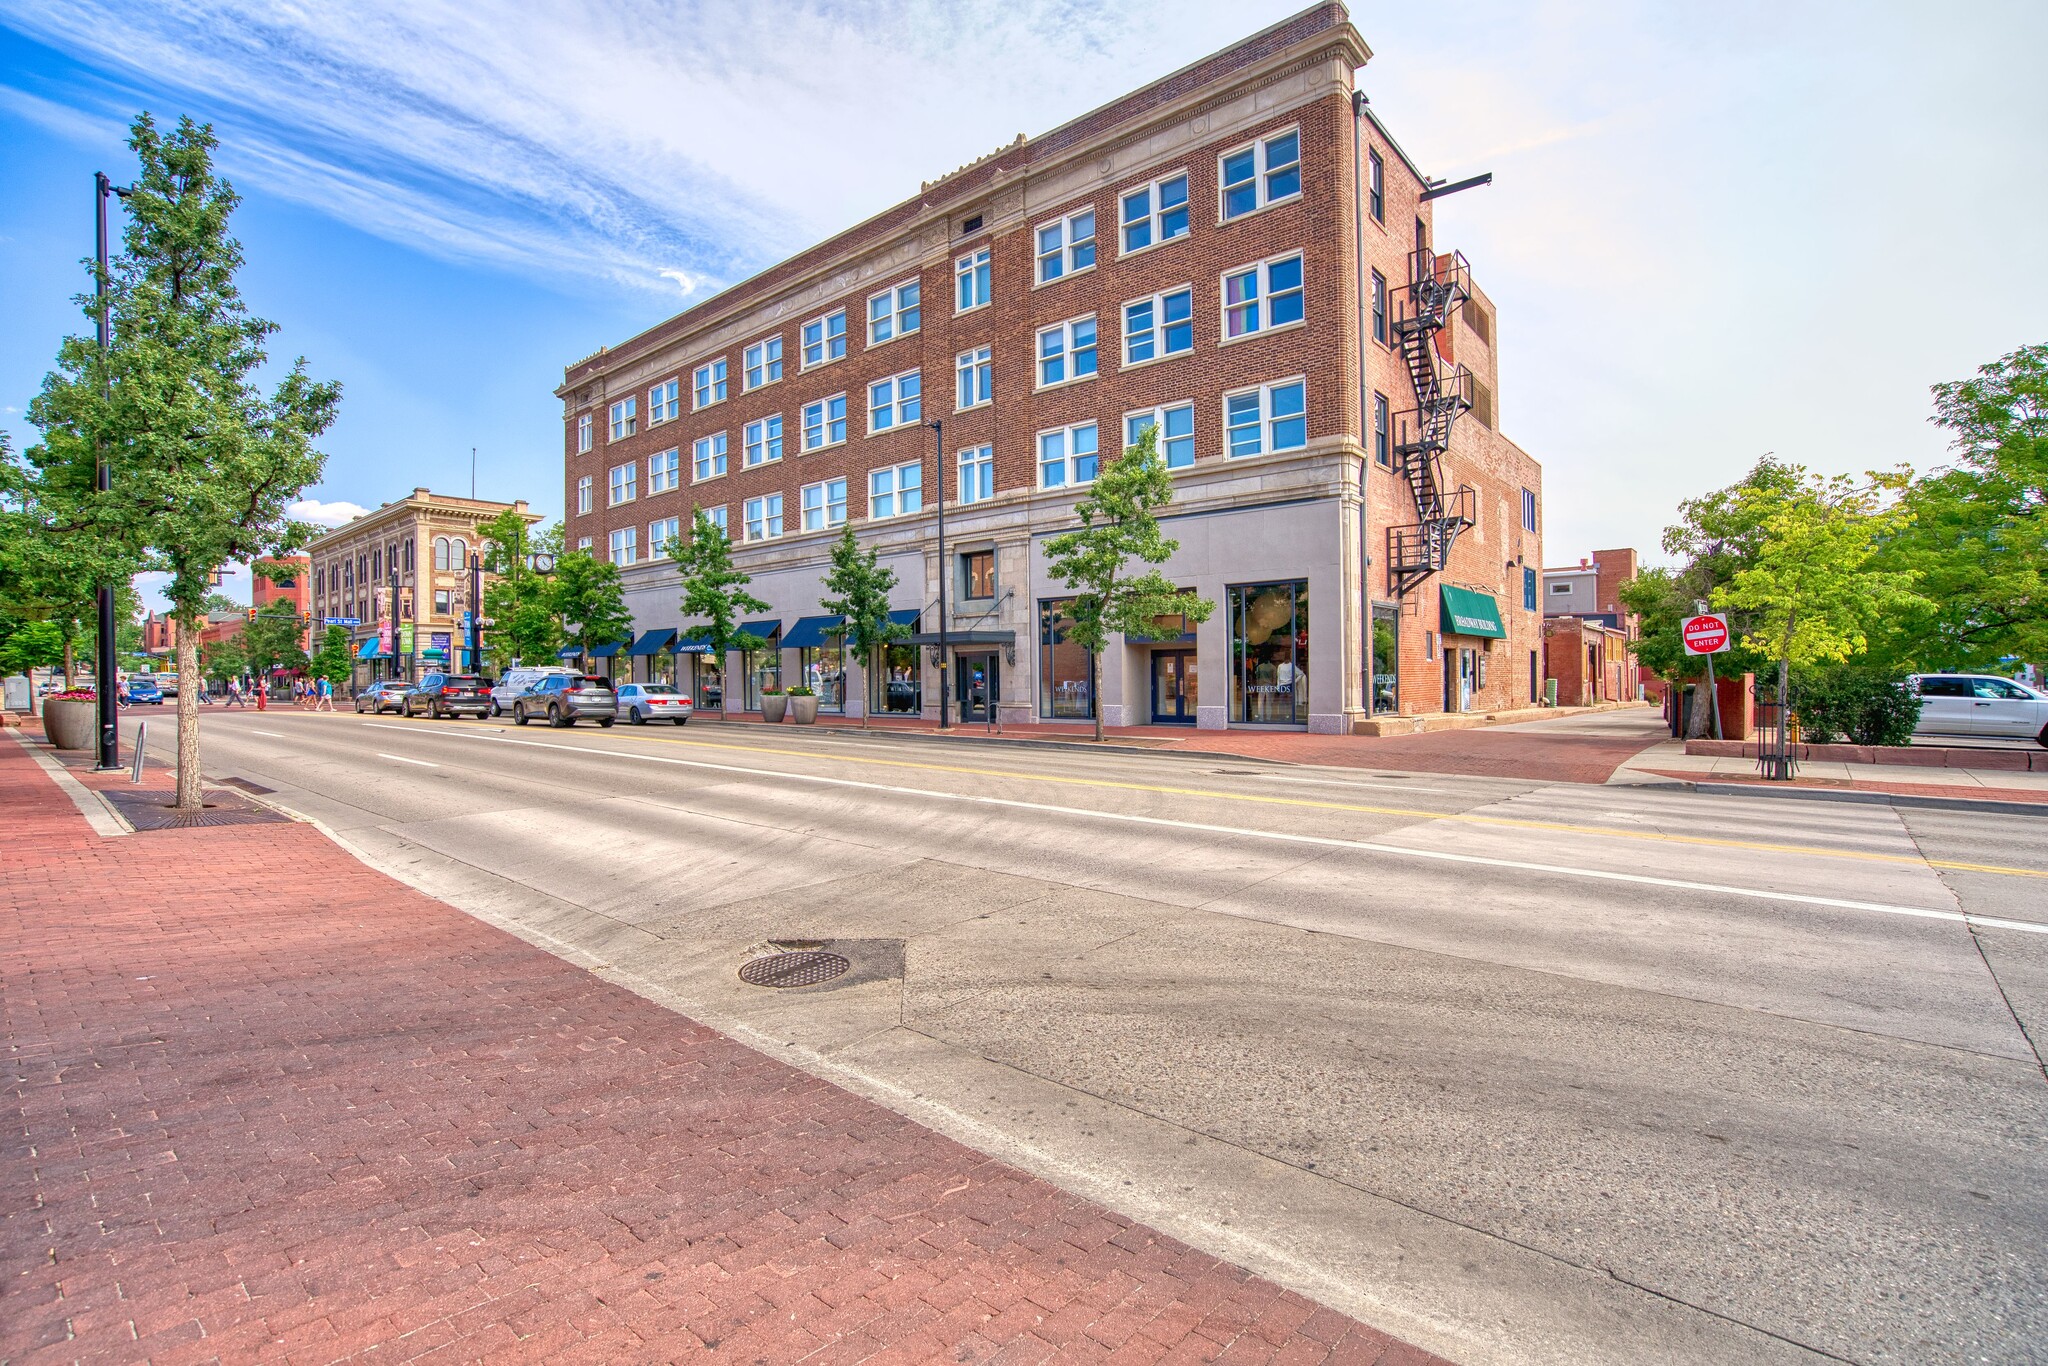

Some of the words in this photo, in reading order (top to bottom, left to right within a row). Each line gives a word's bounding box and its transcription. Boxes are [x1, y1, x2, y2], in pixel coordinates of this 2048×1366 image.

[1454, 615, 1480, 629] BROADWAY
[1478, 618, 1497, 631] BUILDING
[1702, 621, 1719, 630] NOT
[1694, 638, 1719, 647] ENTER
[1055, 685, 1088, 693] WEEKENDS
[1247, 685, 1291, 693] WEEKENDS
